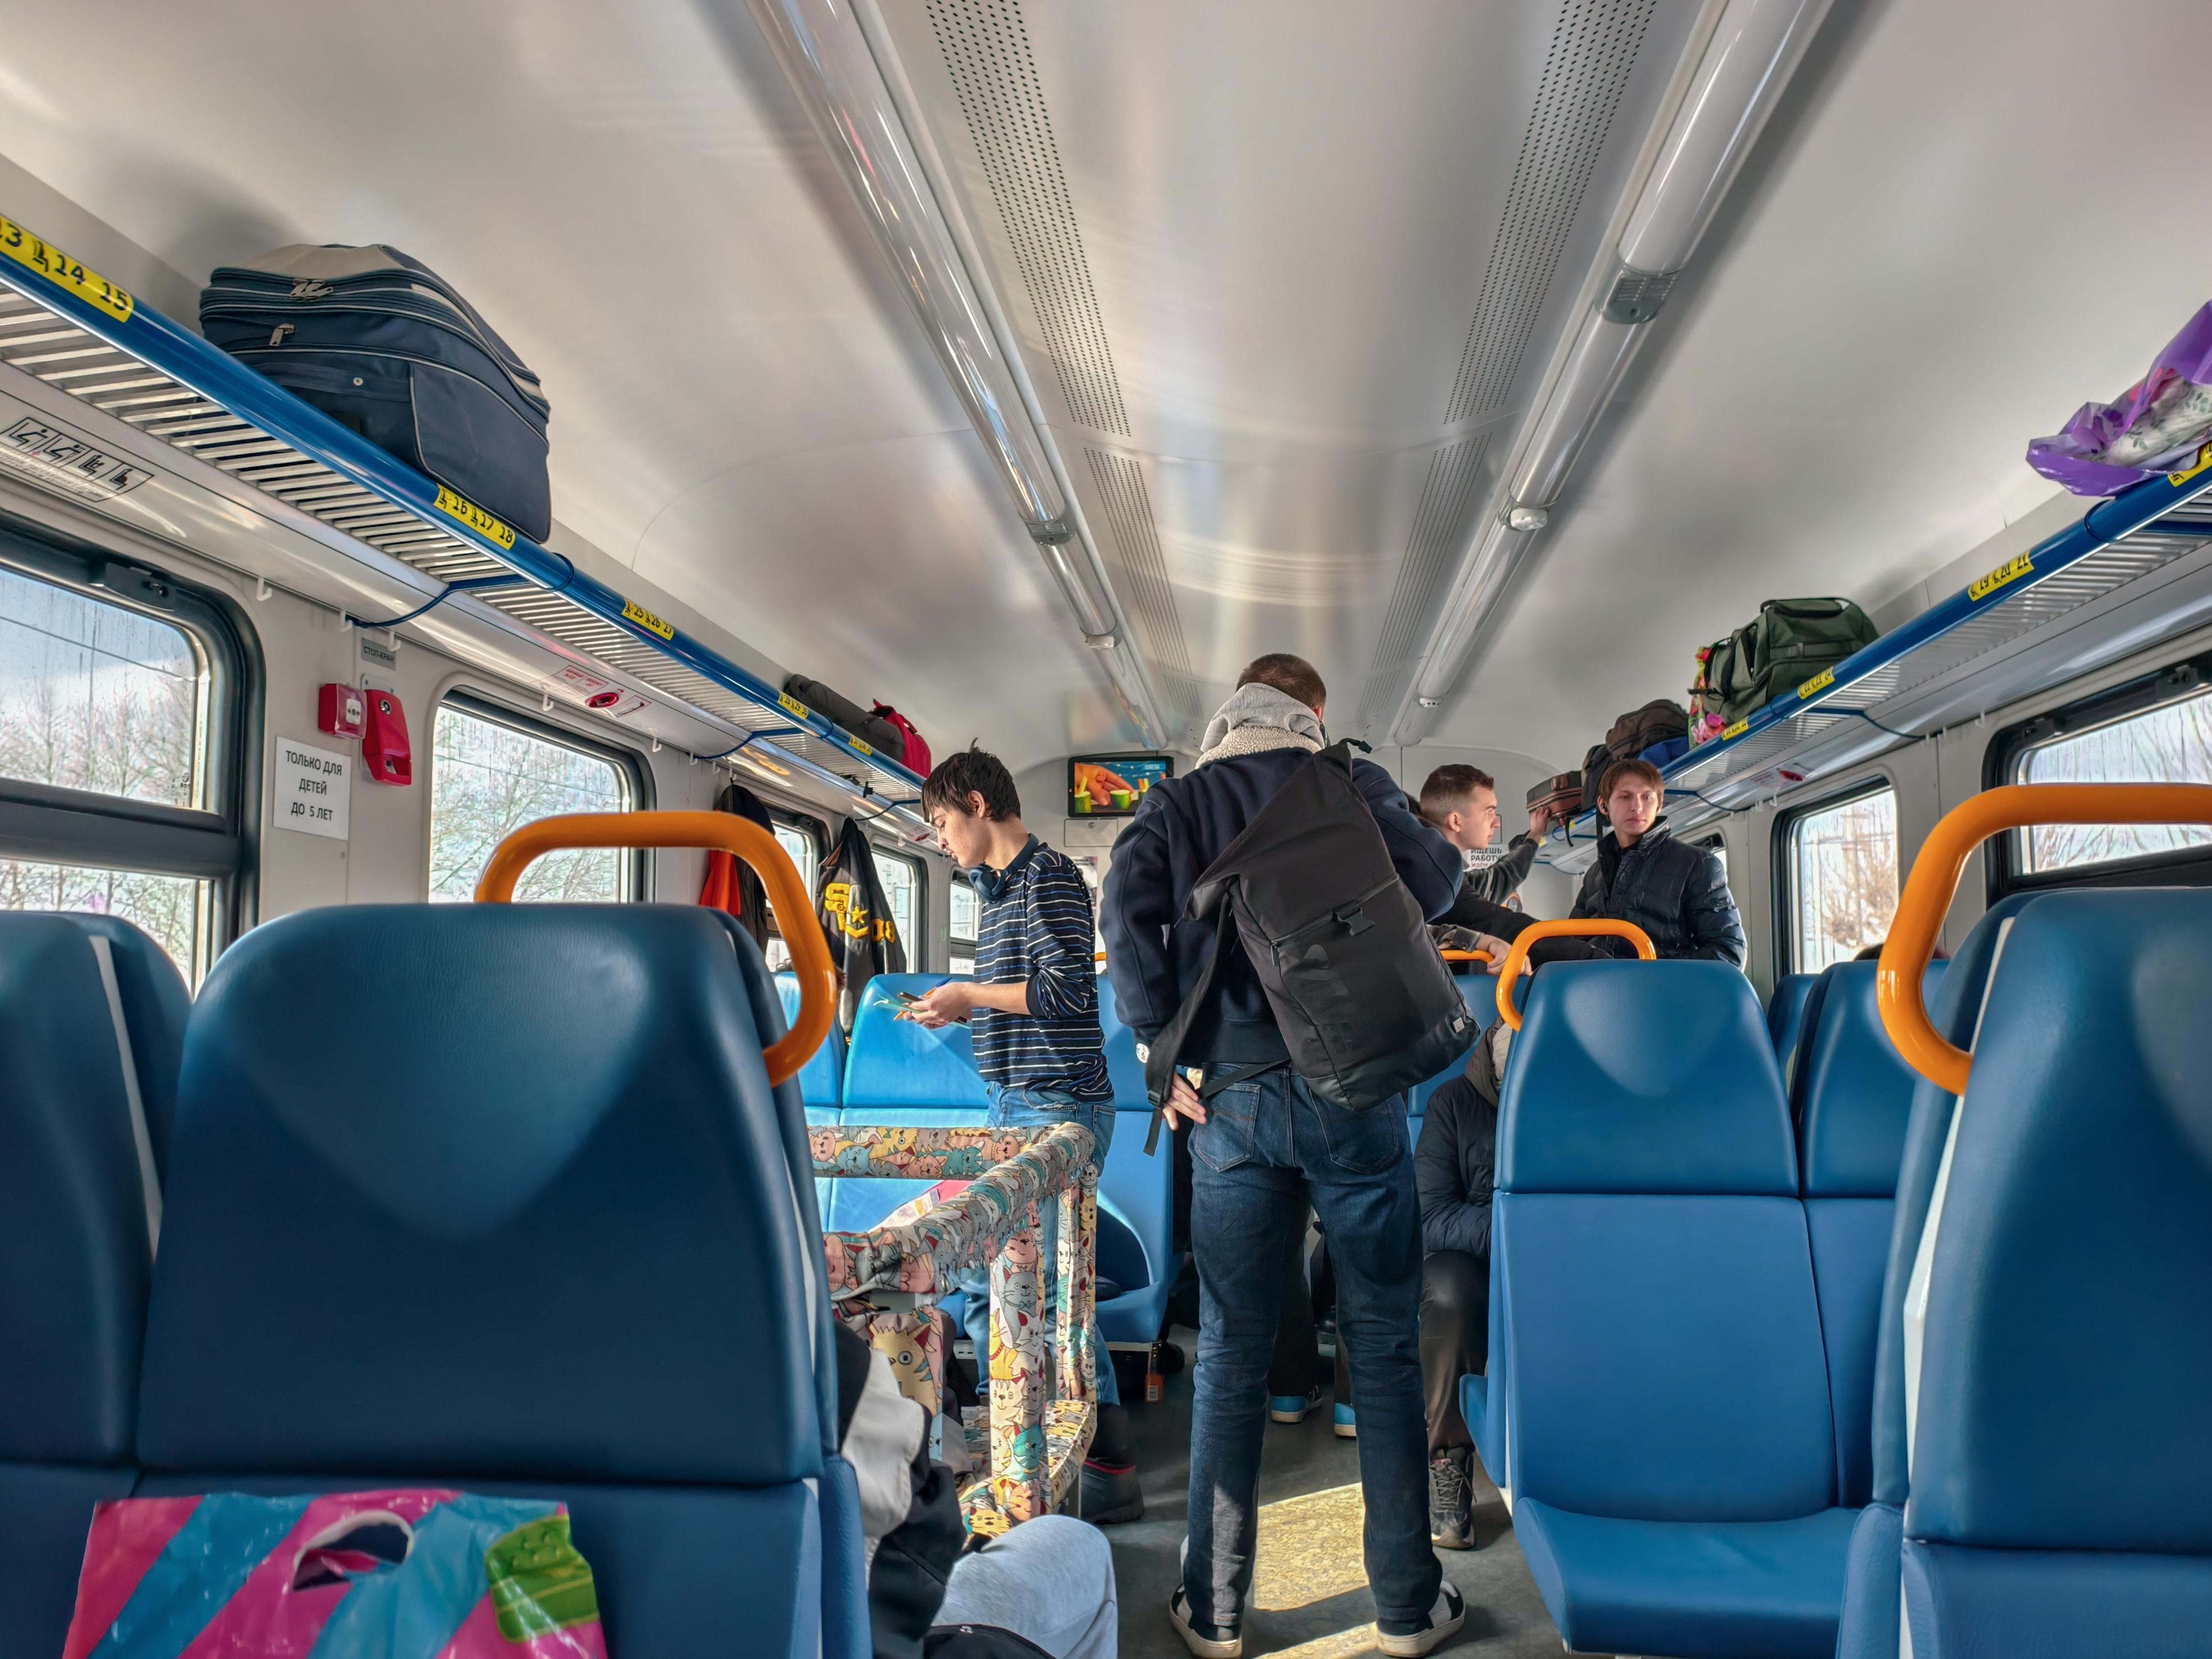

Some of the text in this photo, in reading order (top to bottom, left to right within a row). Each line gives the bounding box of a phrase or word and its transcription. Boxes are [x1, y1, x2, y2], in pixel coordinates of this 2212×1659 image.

[0, 219, 129, 310] 3 14 15
[452, 496, 513, 543] 16 17 18
[1980, 553, 2028, 590] 19 20 21
[634, 604, 672, 635] 25 26 27
[363, 646, 395, 663] СТОП-КРАН
[286, 750, 342, 776] ТОЛЬКО ДЛЯ
[299, 778, 327, 795] ДЕТЕЙ
[291, 801, 333, 821] ДО 5 ЛЕТ
